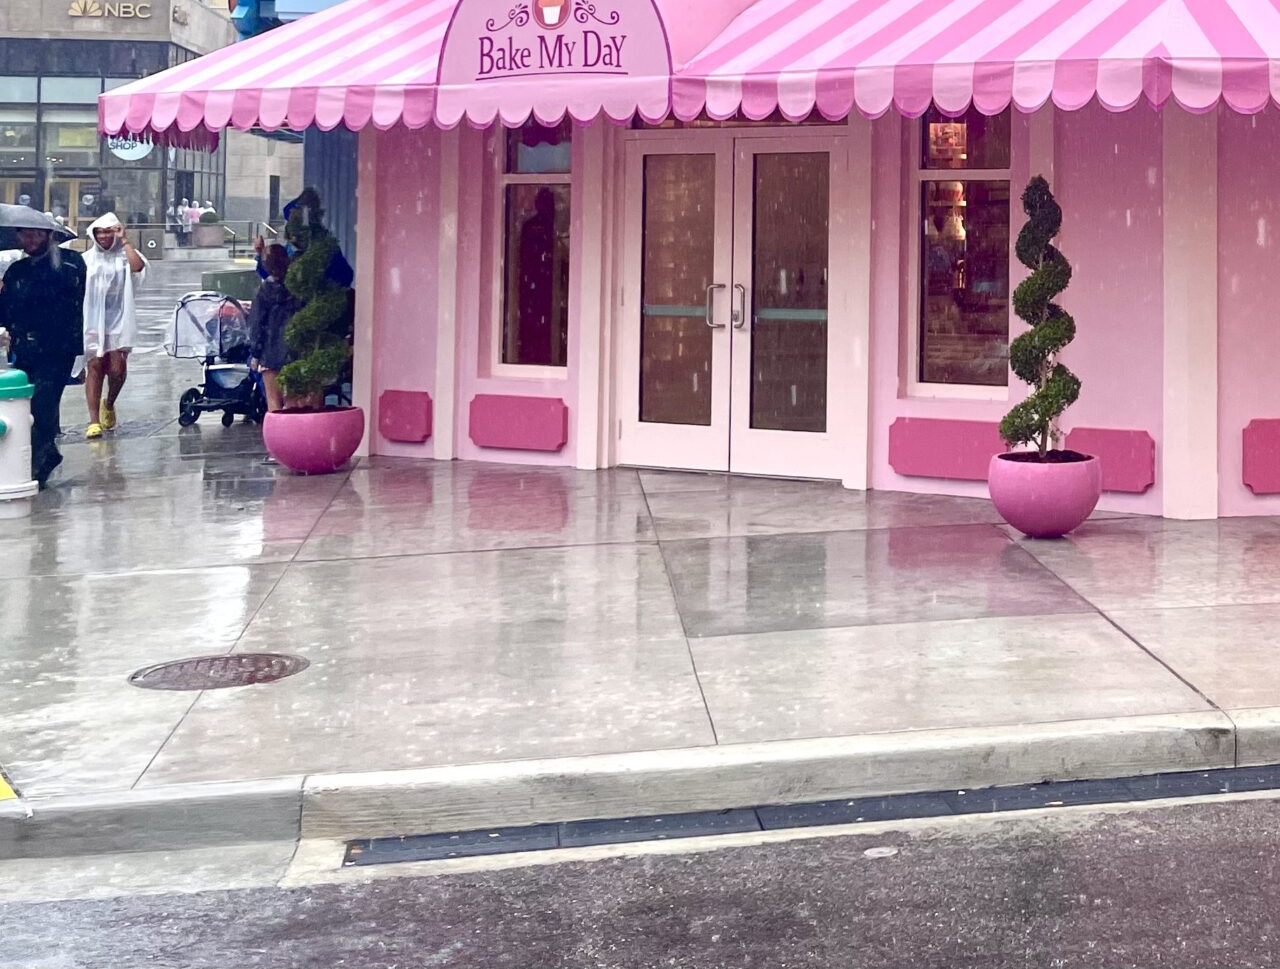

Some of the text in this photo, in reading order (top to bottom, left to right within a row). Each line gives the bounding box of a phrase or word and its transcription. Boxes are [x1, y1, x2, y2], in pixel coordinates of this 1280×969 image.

[104, 2, 152, 19] NBC
[478, 36, 532, 75] Bake
[109, 142, 138, 150] SHOP
